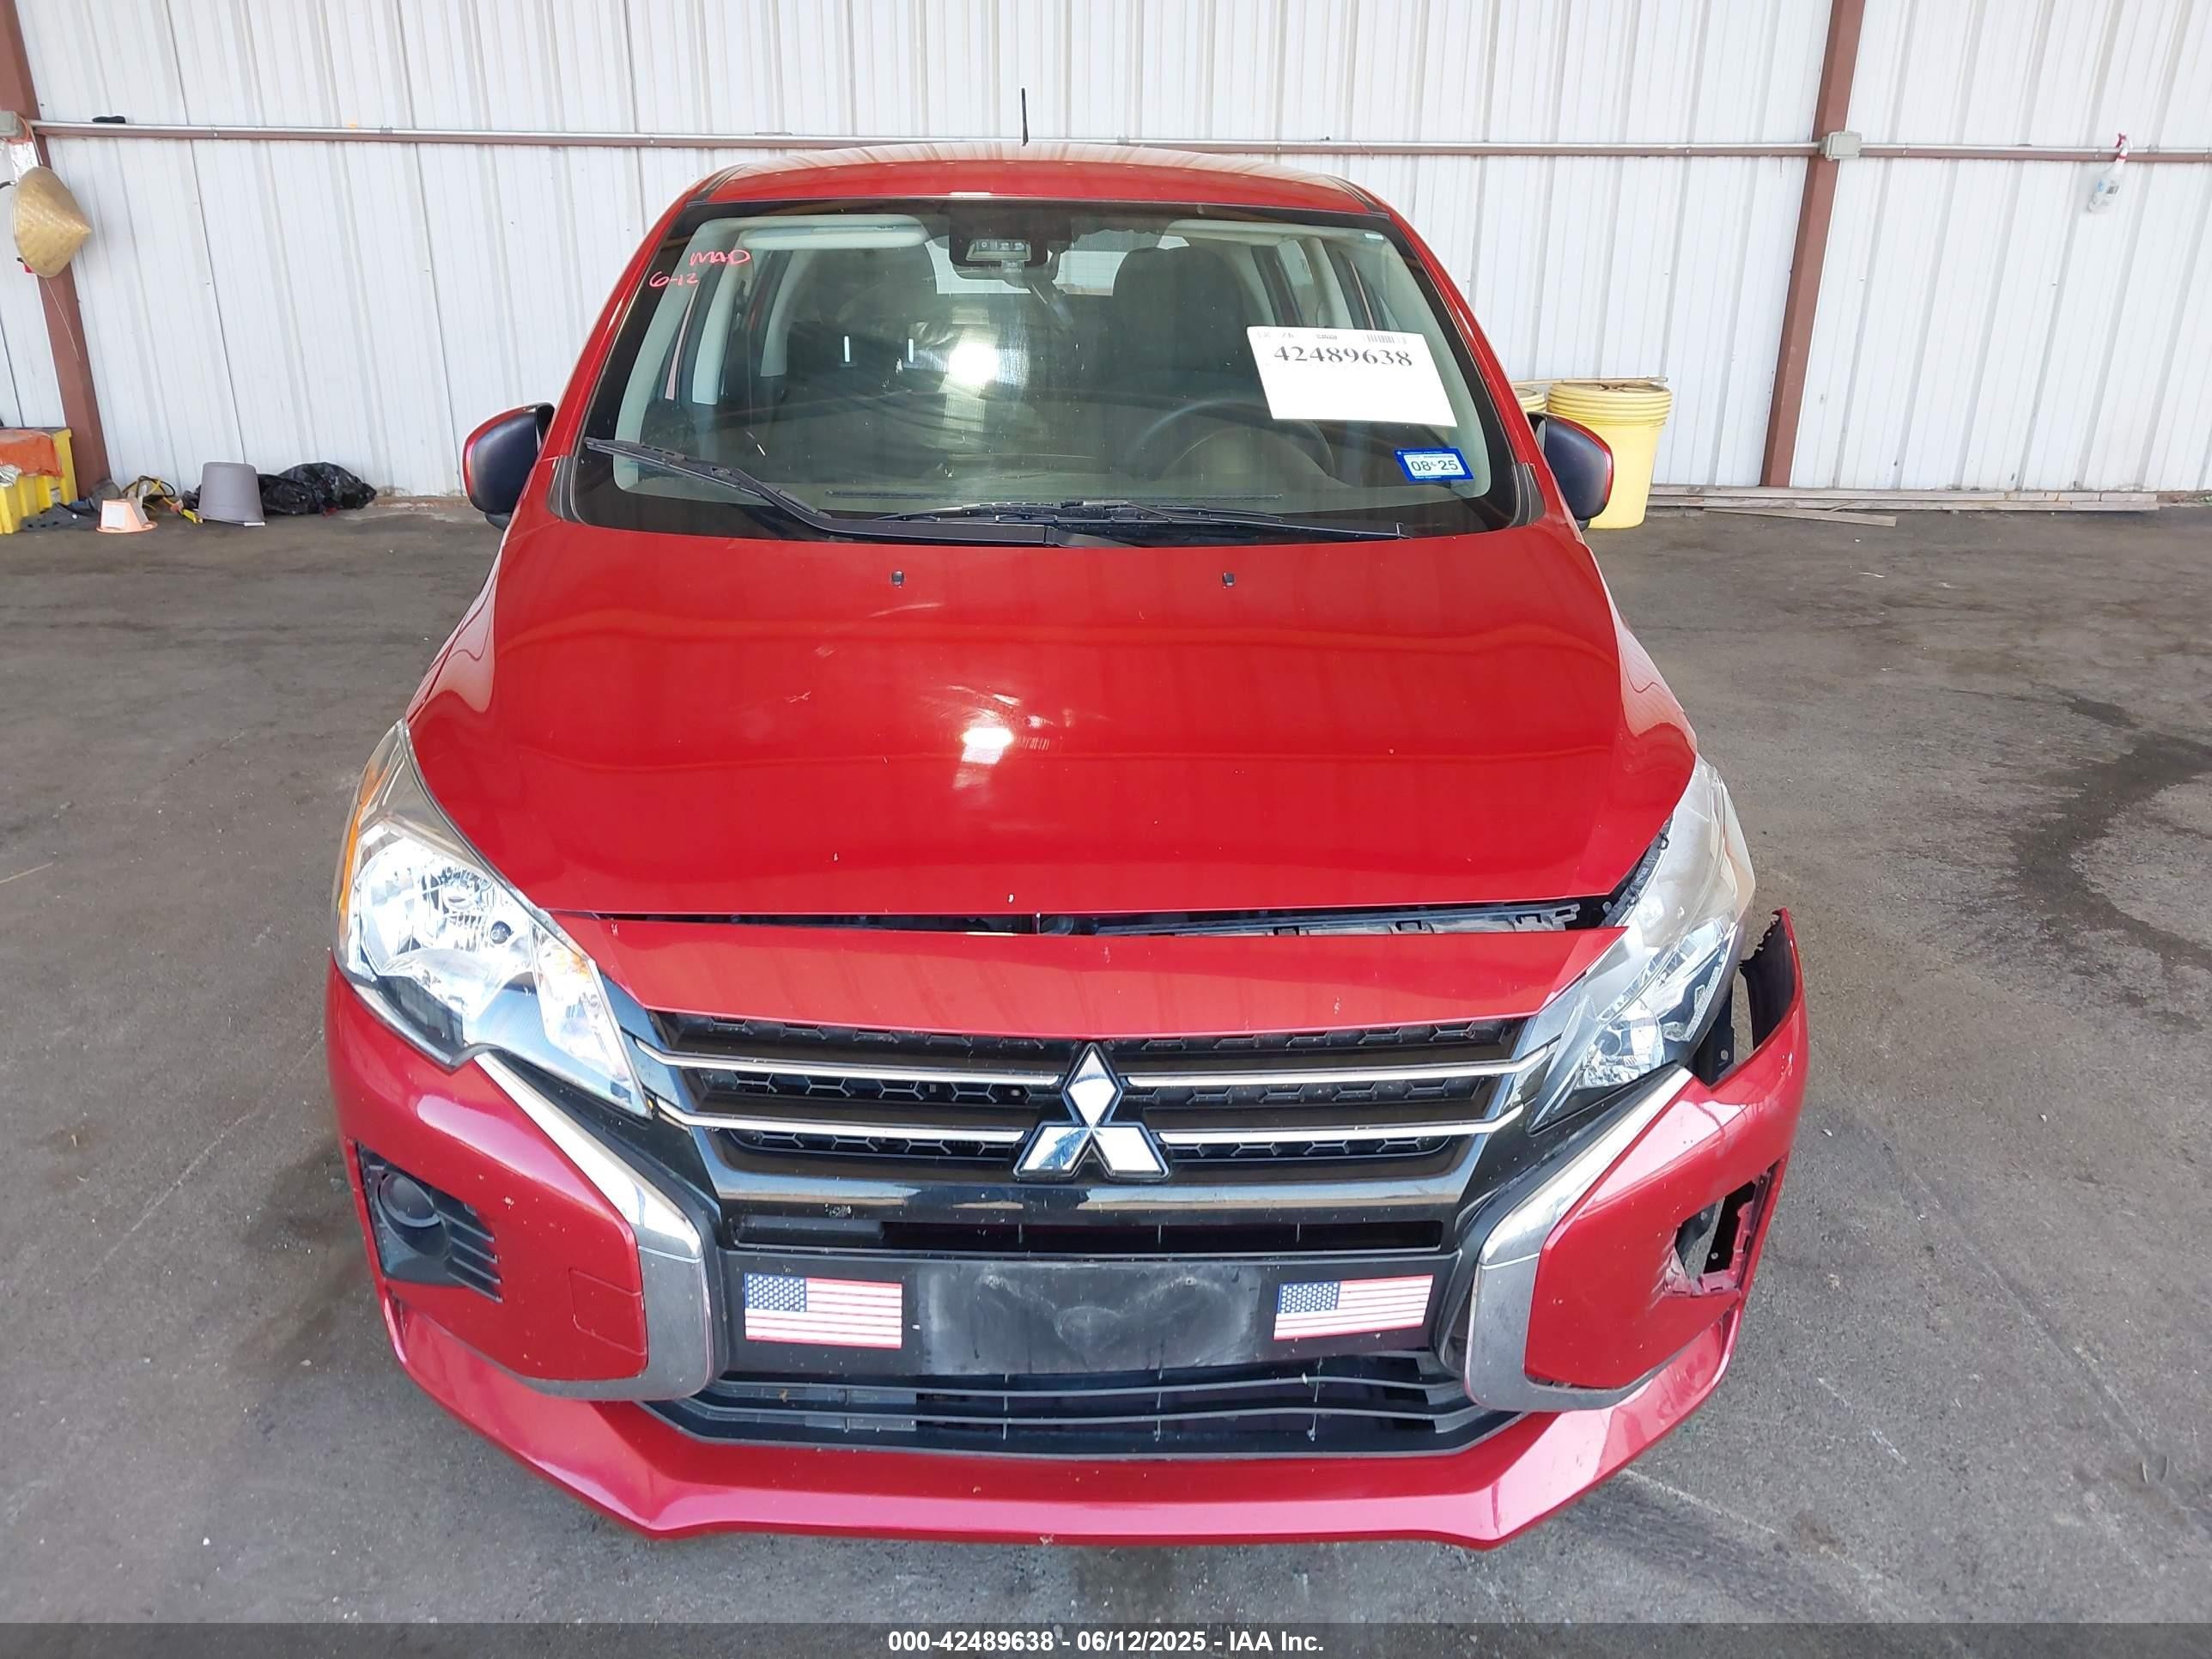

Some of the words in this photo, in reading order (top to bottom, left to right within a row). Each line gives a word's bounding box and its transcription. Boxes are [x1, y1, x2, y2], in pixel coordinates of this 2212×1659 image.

[649, 270, 699, 288] 6-12
[1273, 345, 1413, 367] 42489638
[1411, 460, 1431, 471] 08
[1437, 459, 1458, 471] 25
